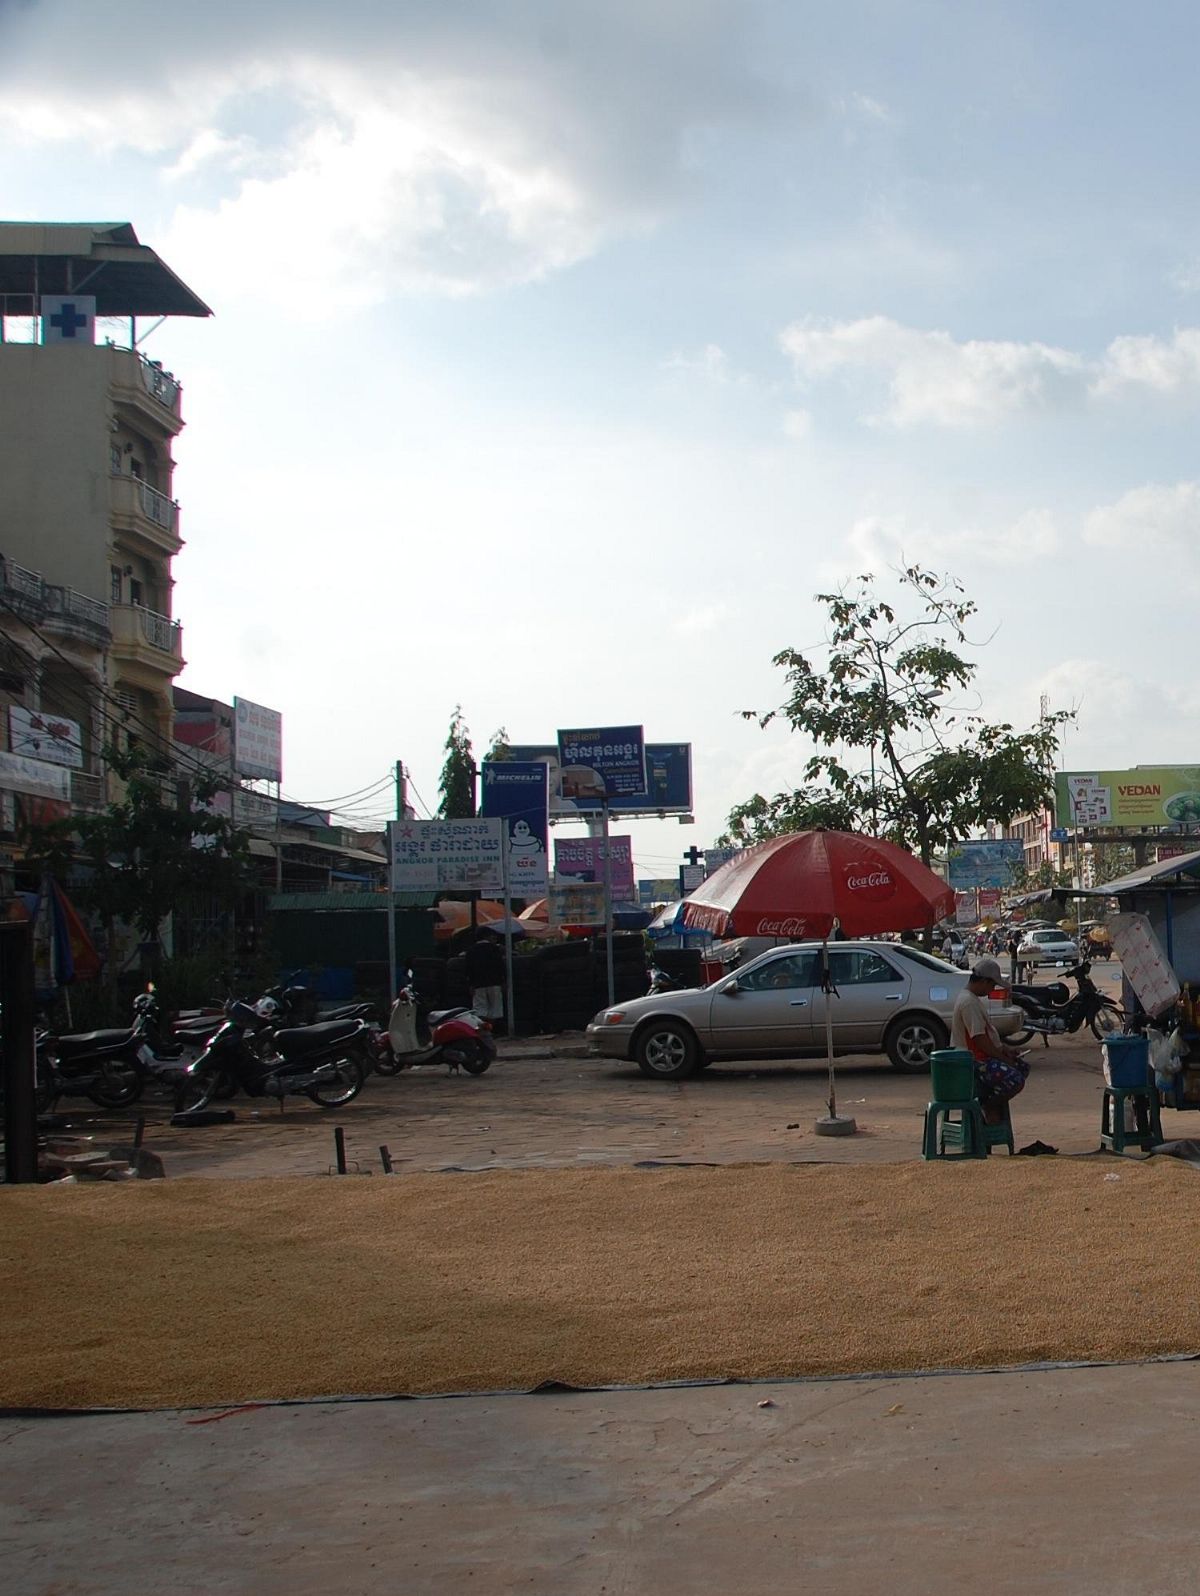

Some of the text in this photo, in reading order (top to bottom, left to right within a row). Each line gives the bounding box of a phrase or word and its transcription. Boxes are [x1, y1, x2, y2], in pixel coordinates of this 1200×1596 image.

[1118, 784, 1161, 796] VEDAN
[437, 856, 479, 864] PARADISE
[847, 872, 890, 889] Coca-Cola
[757, 917, 807, 936] Coca-Cola
